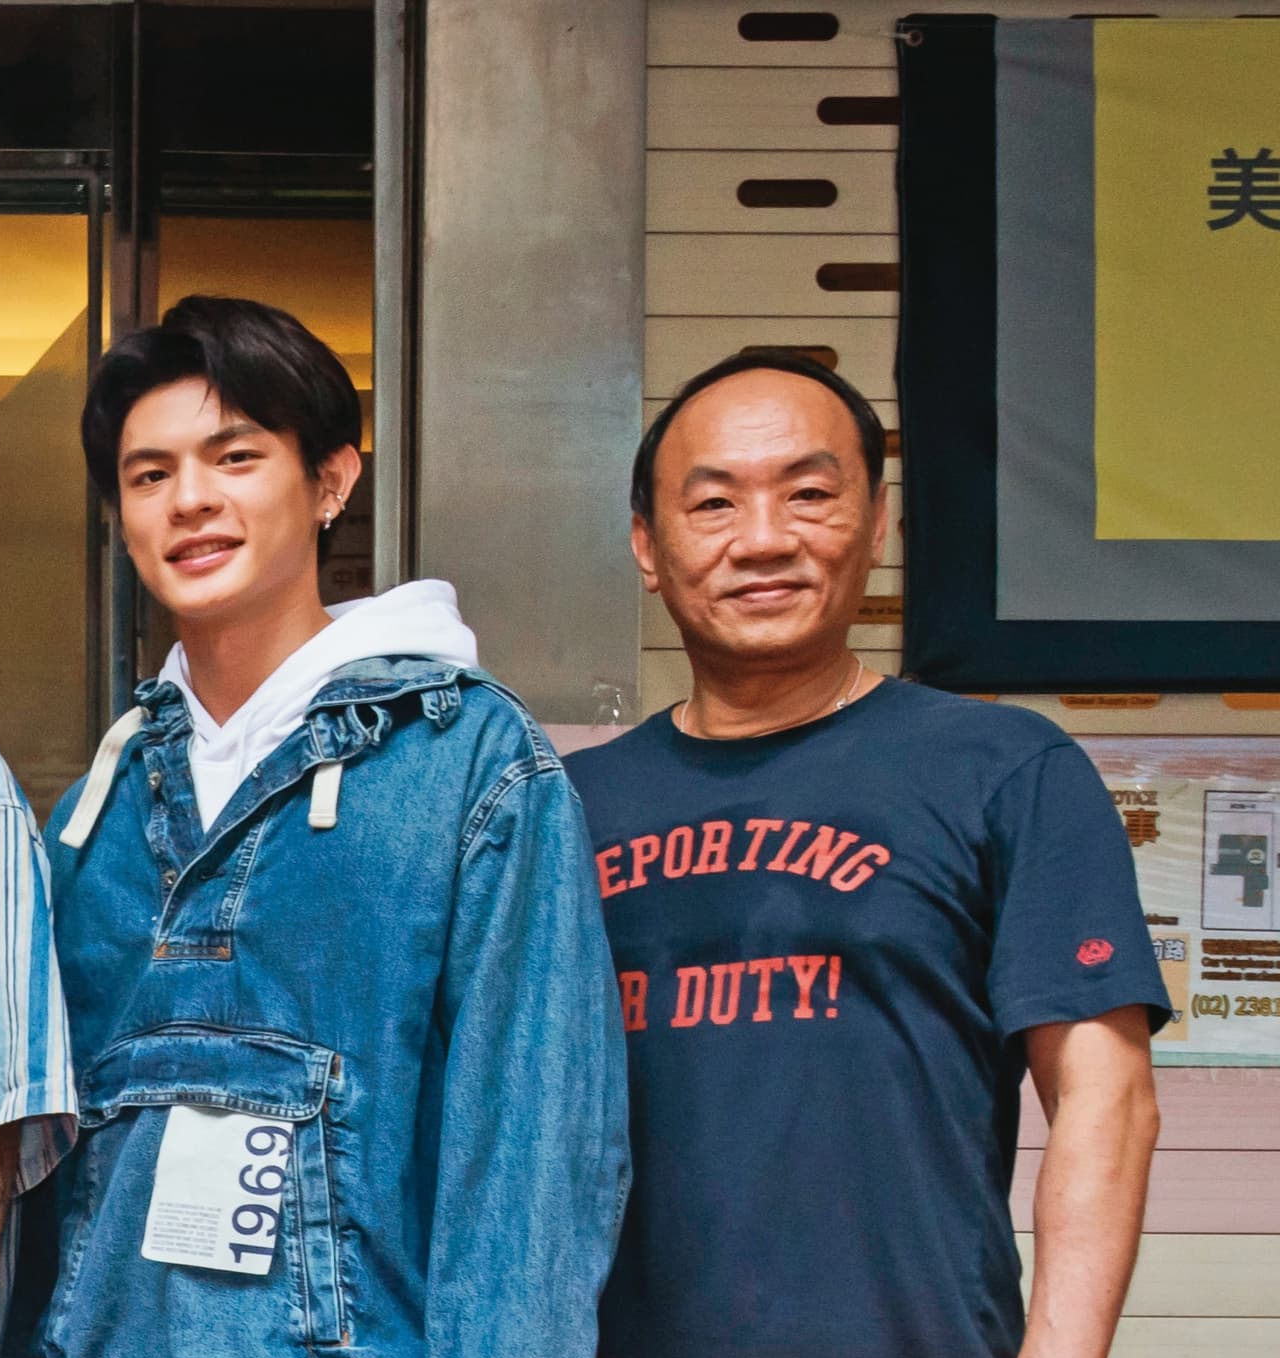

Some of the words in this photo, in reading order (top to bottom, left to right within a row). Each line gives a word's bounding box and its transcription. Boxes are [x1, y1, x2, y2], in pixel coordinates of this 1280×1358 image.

[1207, 148, 1280, 231] 美
[670, 954, 842, 1029] DUTY!
[1191, 993, 1230, 1019] (02)
[229, 1125, 293, 1264] 1969
